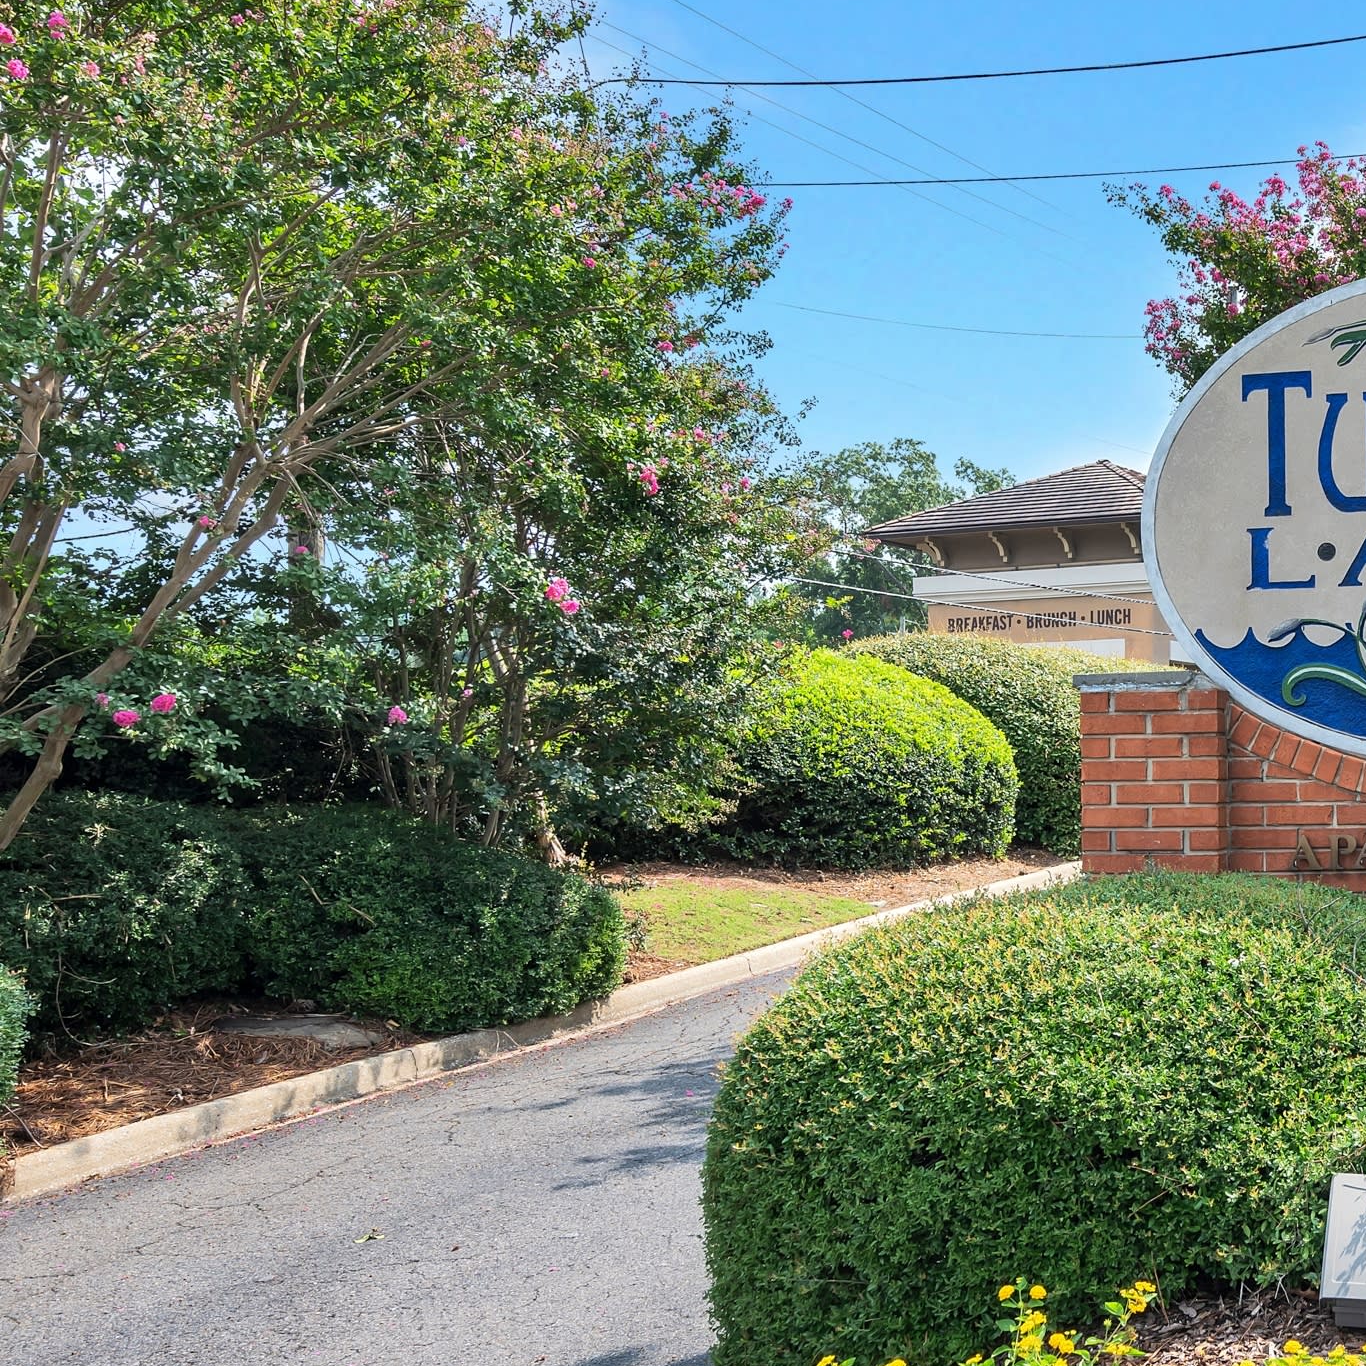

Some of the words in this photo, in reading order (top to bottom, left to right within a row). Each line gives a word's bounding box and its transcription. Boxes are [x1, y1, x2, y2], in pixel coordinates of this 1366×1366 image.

[947, 614, 1014, 633] BREAKFAST
[1026, 611, 1077, 629] BRUNCH
[1090, 608, 1132, 625] LUNCH
